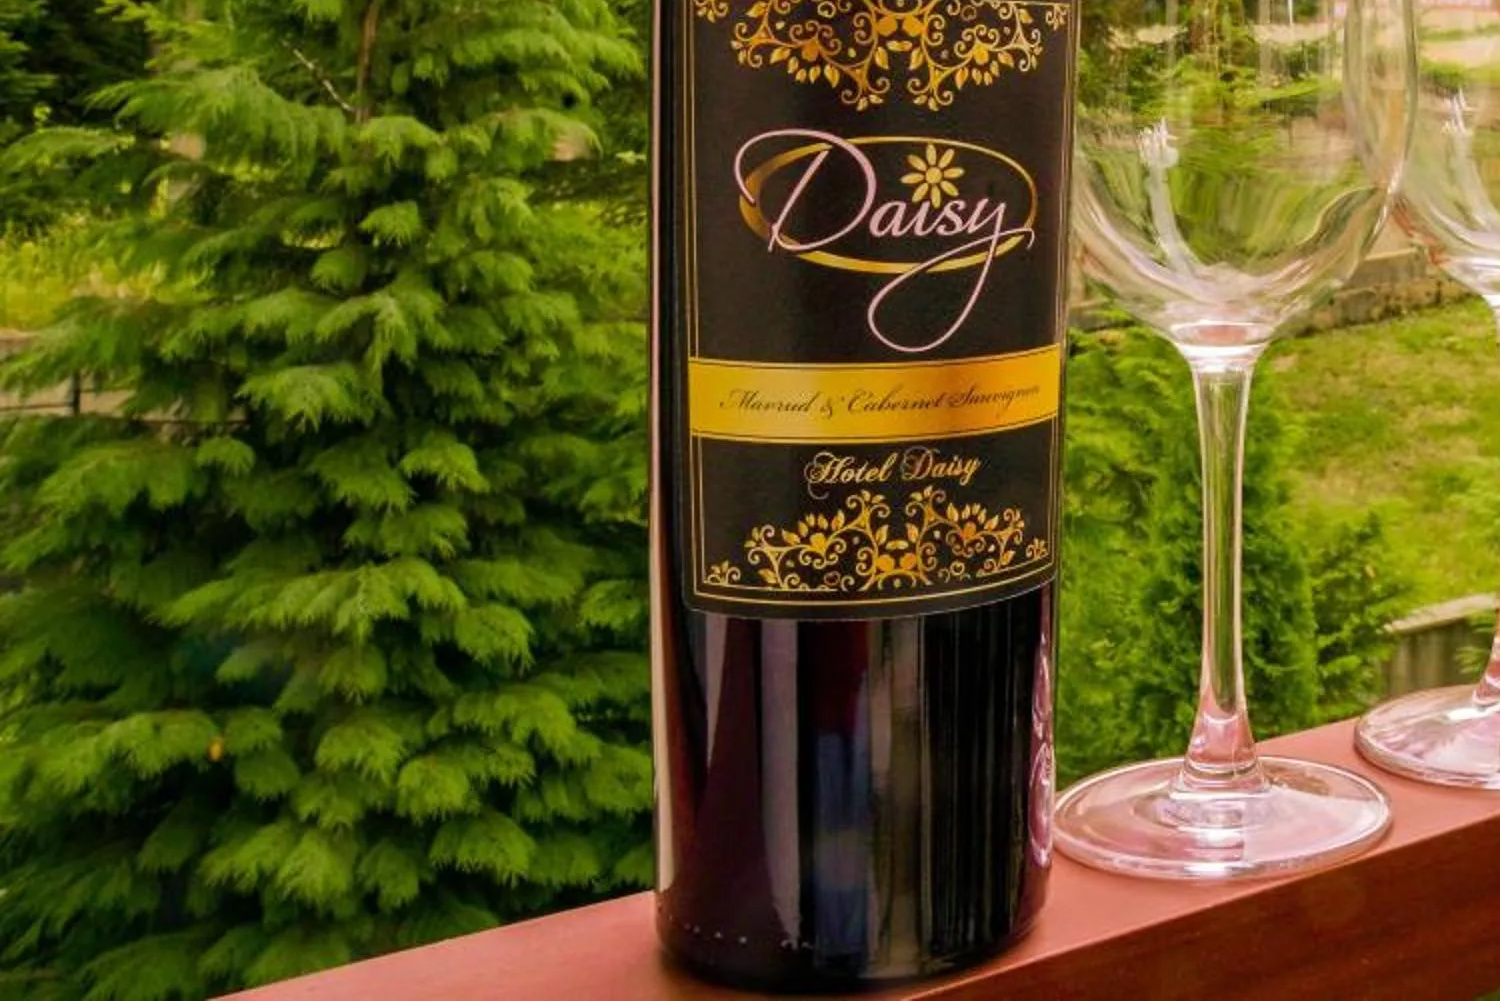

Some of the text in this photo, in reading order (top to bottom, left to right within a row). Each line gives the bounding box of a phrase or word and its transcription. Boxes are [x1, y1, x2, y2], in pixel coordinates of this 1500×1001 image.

[734, 128, 1036, 352] Daisy
[840, 384, 945, 413] Cabernet
[804, 445, 982, 499] Hotel Daisy
